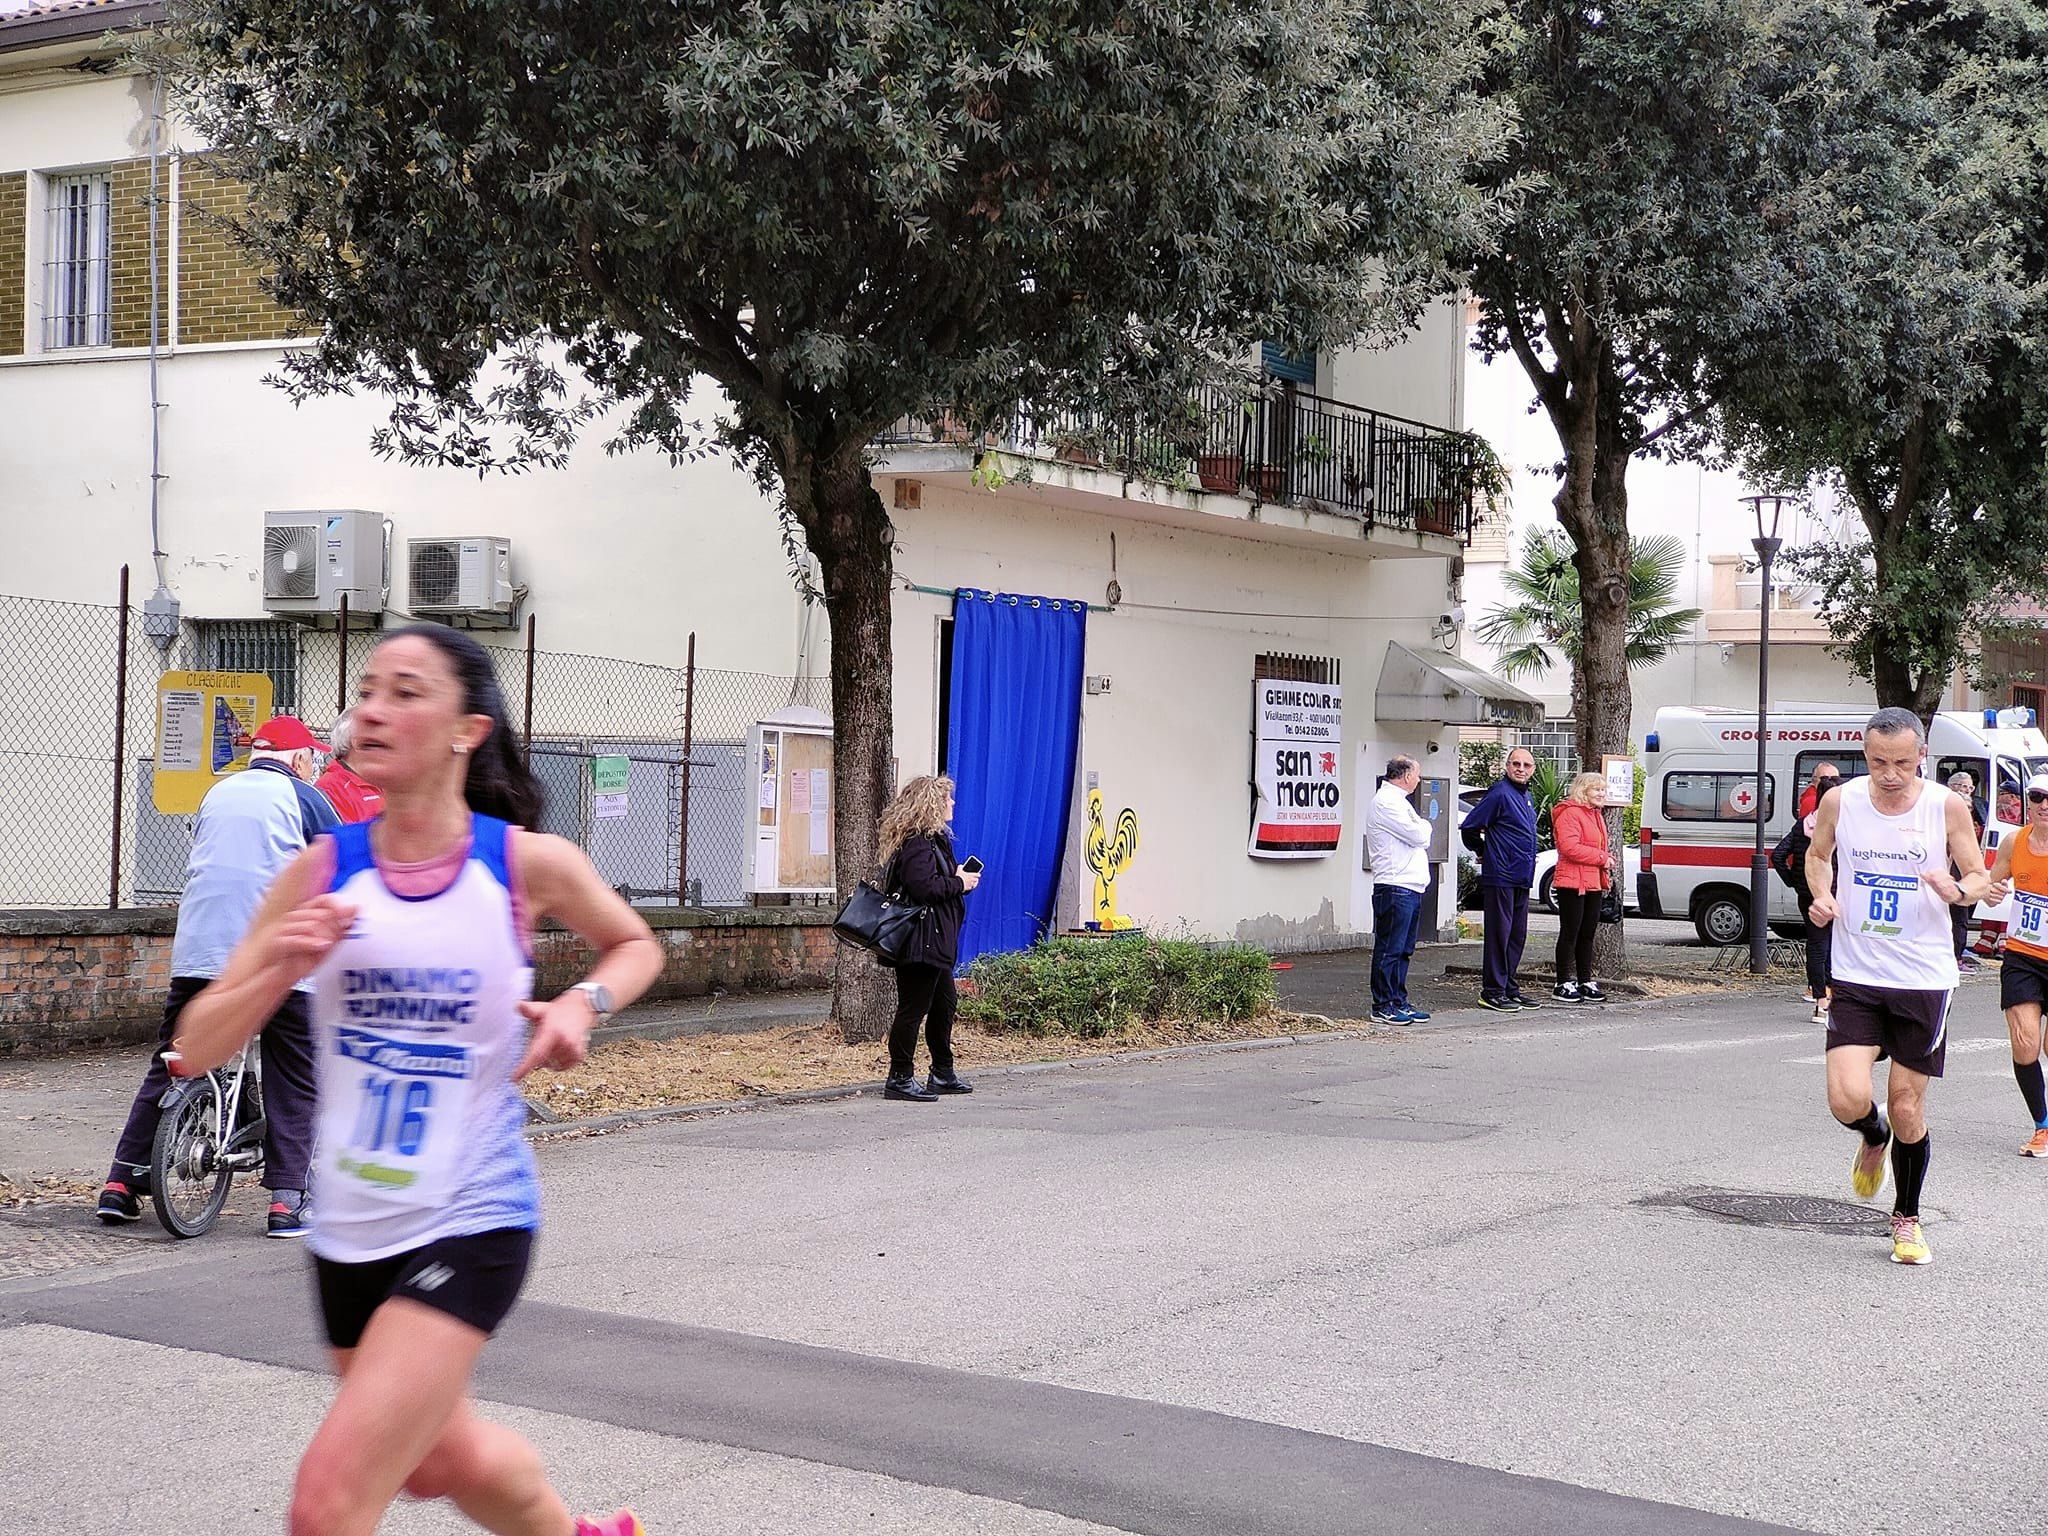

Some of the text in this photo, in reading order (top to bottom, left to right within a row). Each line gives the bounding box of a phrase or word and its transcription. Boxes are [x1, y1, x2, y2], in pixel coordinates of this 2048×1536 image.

[186, 673, 242, 688] CLASSIFICHE
[1101, 677, 1110, 690] 68
[1778, 730, 1831, 741] ROSSA
[1837, 730, 1863, 741] ITA
[1276, 750, 1312, 776] san
[1277, 781, 1339, 808] marco
[1869, 889, 1899, 922] 63
[2021, 905, 2042, 931] 59
